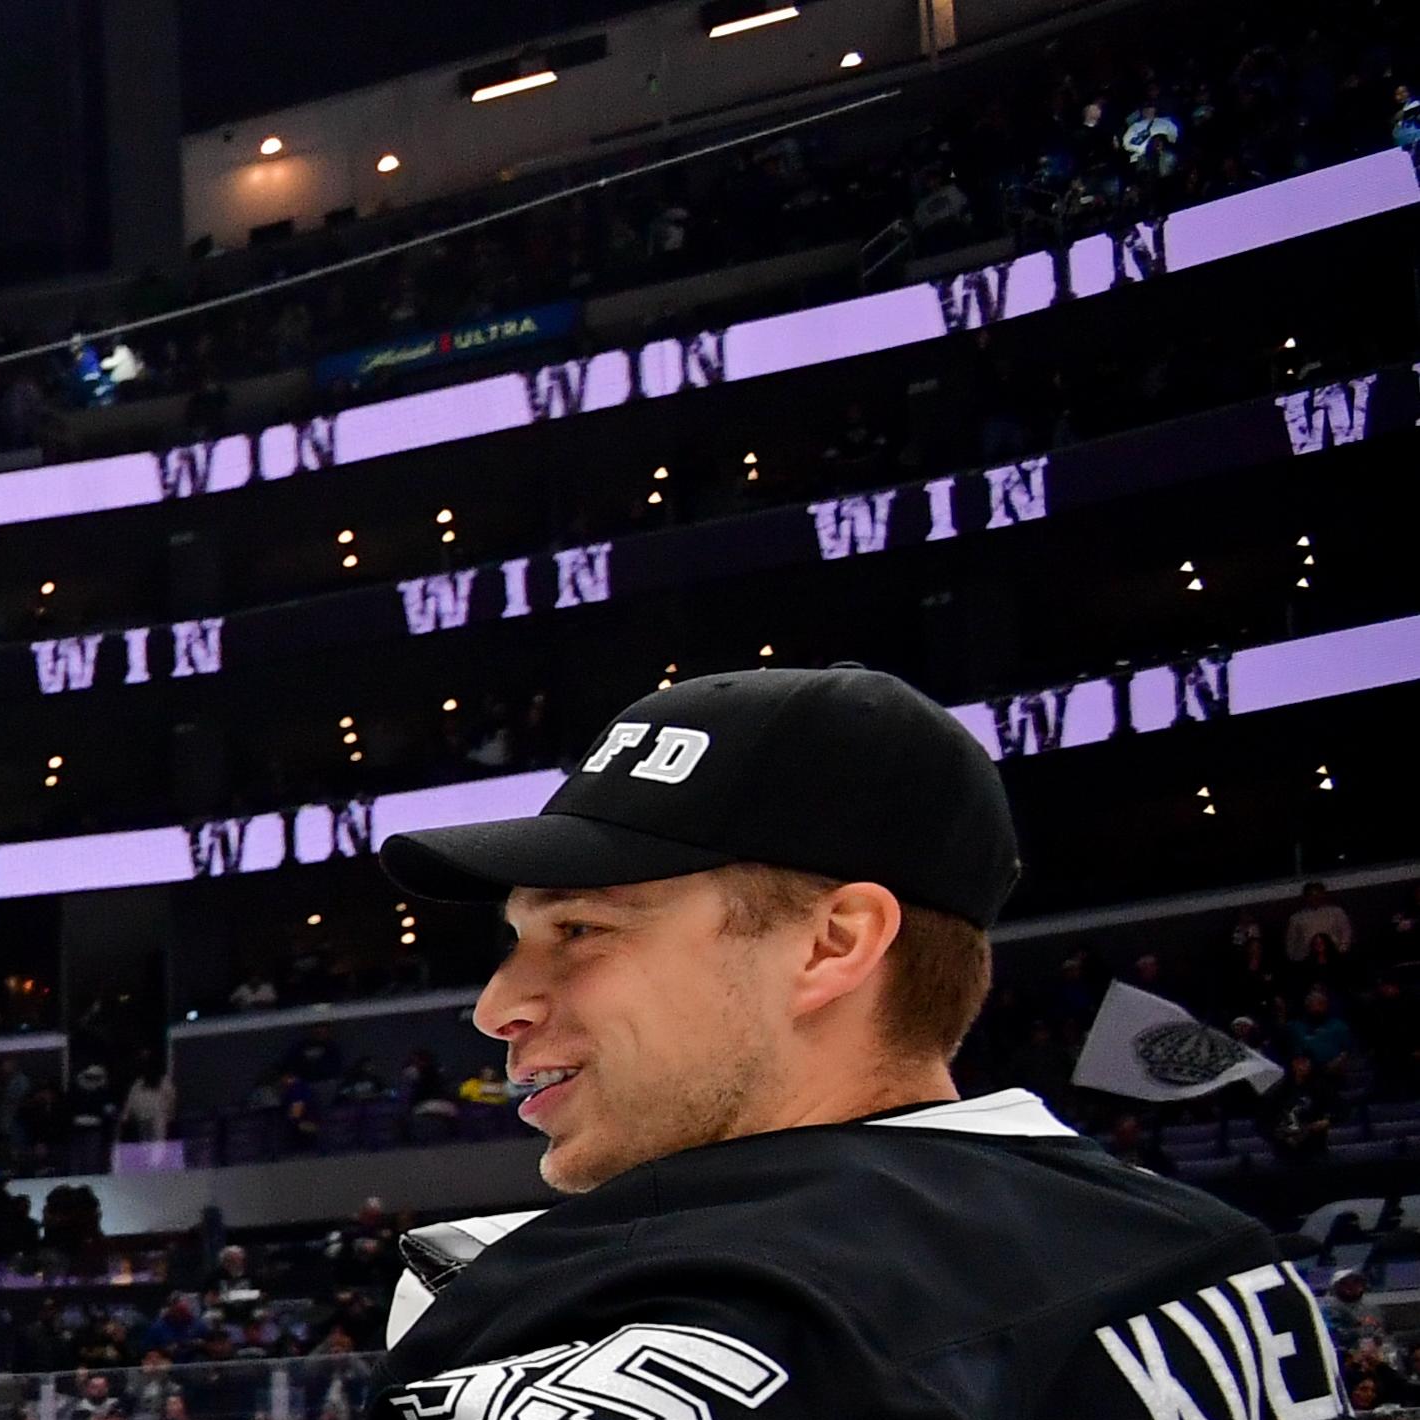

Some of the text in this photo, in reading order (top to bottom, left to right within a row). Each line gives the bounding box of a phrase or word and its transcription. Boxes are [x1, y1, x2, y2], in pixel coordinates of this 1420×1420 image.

[807, 455, 1051, 561] WIN
[396, 542, 613, 637] WIN
[30, 617, 225, 696] WIN
